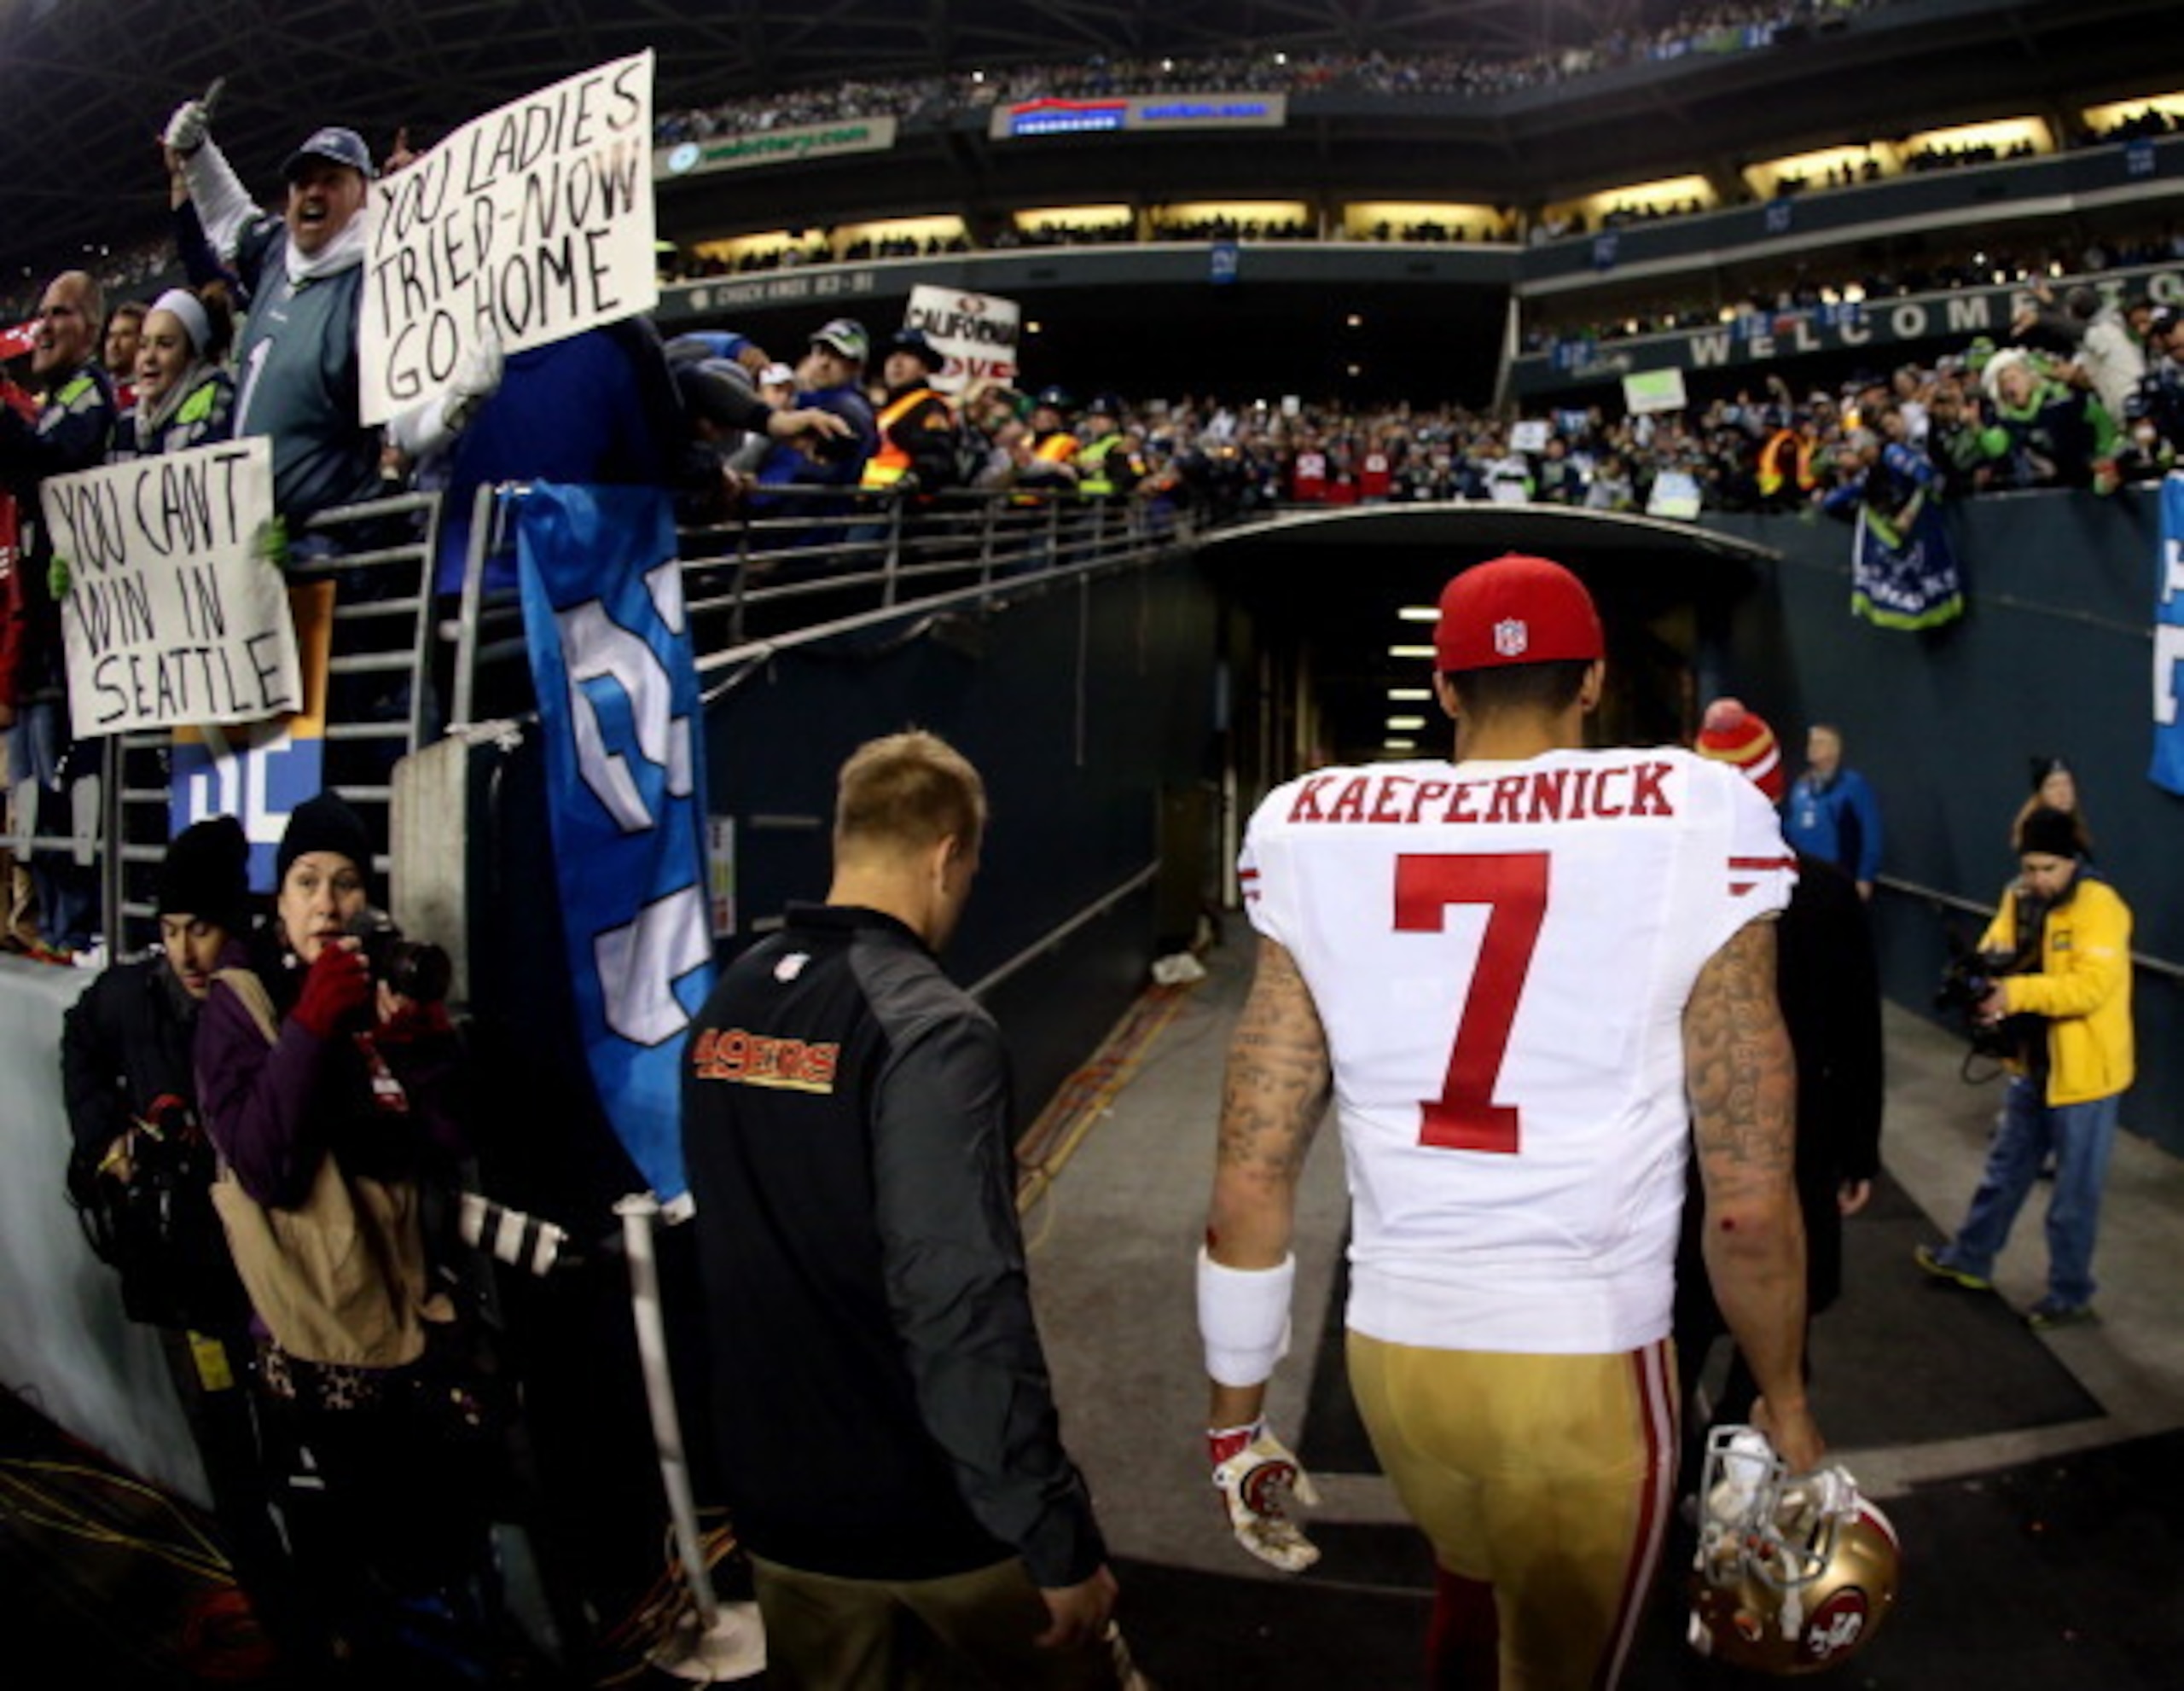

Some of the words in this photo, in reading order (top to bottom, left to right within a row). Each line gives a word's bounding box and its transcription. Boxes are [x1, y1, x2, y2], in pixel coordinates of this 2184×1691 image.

[375, 147, 451, 255] YOU
[465, 62, 642, 195] LADIES
[386, 308, 457, 400] GO
[473, 228, 624, 343] HOME
[53, 478, 125, 575] YOU
[135, 450, 251, 556] CANT
[73, 569, 154, 658] WIN
[176, 562, 227, 640] IN
[93, 630, 291, 725] SEATTLE
[1287, 762, 1675, 825] KAEPERNICK
[693, 1027, 841, 1084] 49ERS
[1392, 849, 1552, 1155] 7
